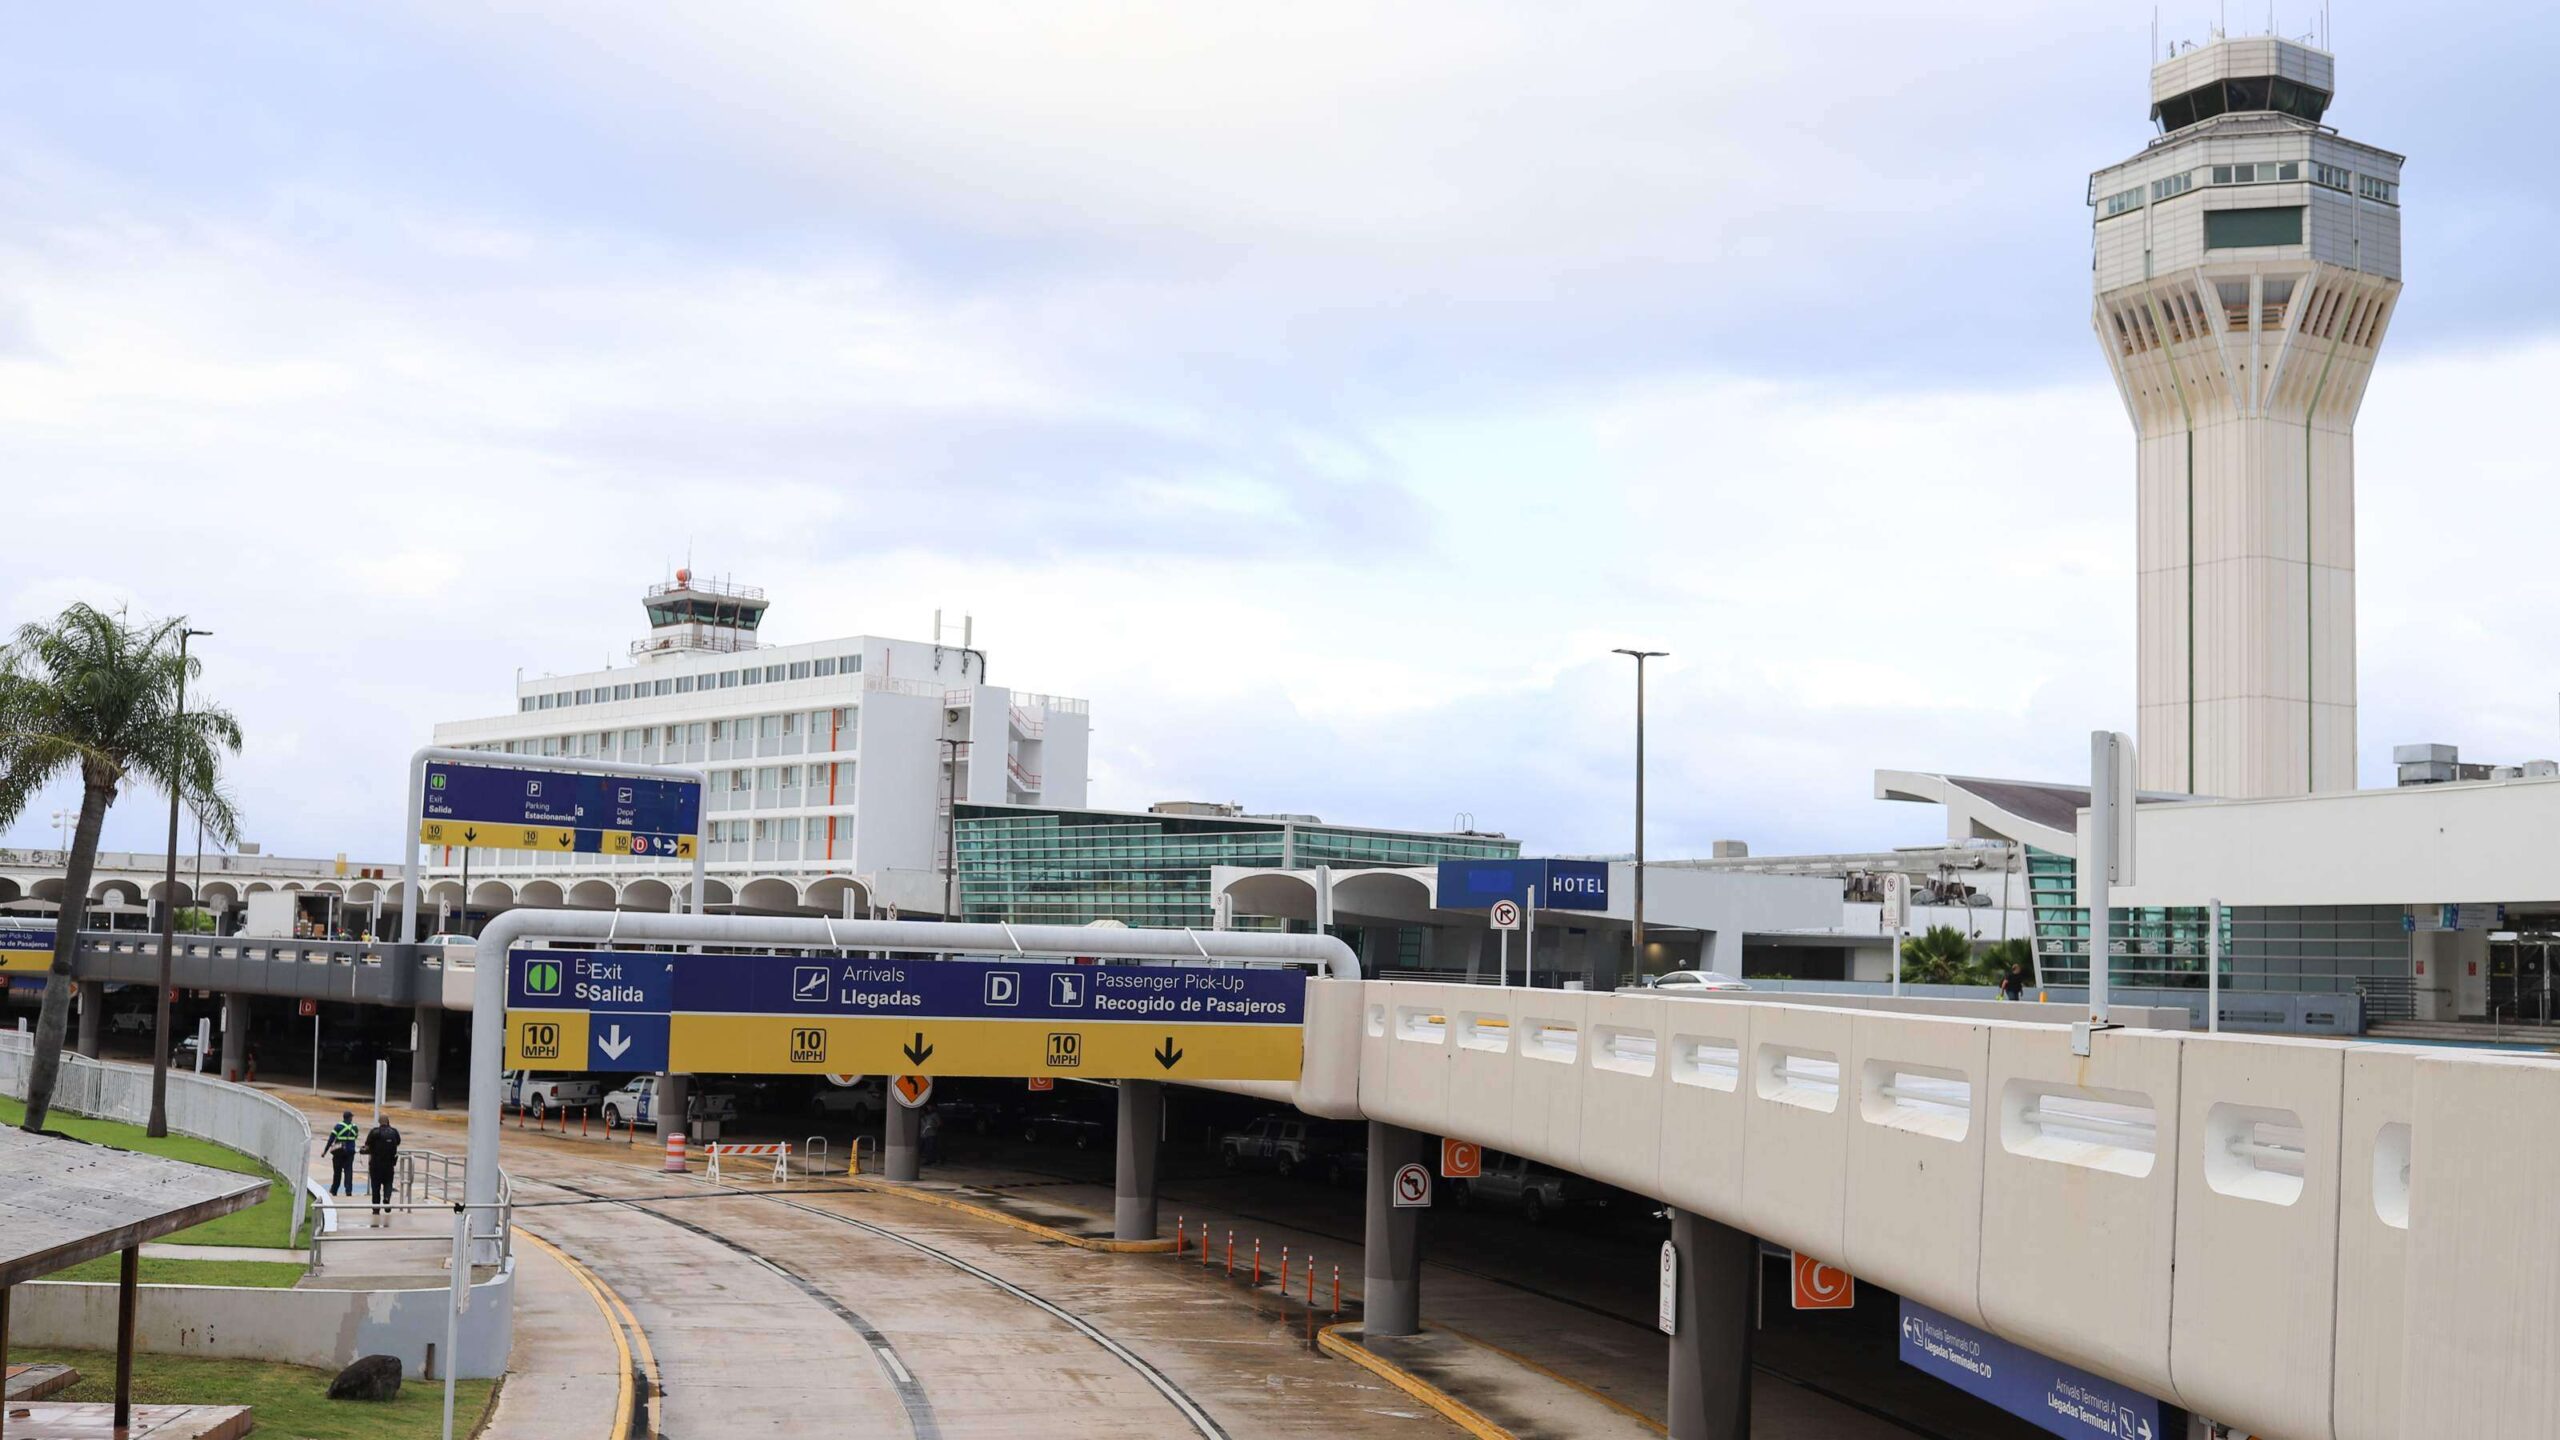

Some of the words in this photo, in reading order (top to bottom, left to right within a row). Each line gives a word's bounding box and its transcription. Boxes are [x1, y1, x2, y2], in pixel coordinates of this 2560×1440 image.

[530, 784, 538, 794] P
[429, 795, 443, 803] Exit
[525, 801, 550, 811] Parking
[429, 805, 452, 814] Salida
[617, 808, 636, 817] Depa
[430, 825, 440, 835] 10
[526, 832, 536, 841] 10
[618, 837, 626, 845] 10
[637, 839, 644, 850] D
[1552, 876, 1605, 894] HOTEL
[843, 966, 905, 983] Arrivals
[1095, 972, 1180, 992] Passenger
[1185, 974, 1245, 992] Pick-Up
[589, 985, 644, 1002] Salida
[991, 977, 1013, 1001] D
[305, 1002, 312, 1012] D
[841, 989, 921, 1008] Llegadas
[1095, 995, 1176, 1014] Recogido
[1181, 996, 1201, 1012] de
[1206, 997, 1286, 1016] Pasajeros
[528, 1025, 554, 1045] 10
[796, 1030, 821, 1050] 10
[525, 1046, 555, 1057] MPH
[1052, 1035, 1076, 1055] 10
[793, 1050, 823, 1061] MPH
[1049, 1055, 1078, 1065] MPH
[1454, 1146, 1468, 1168] C
[1812, 1264, 1835, 1295] C
[1925, 1322, 1943, 1341] Arrivals
[1943, 1329, 1969, 1351] Terminals
[1969, 1340, 1980, 1356] C/D
[1924, 1339, 1948, 1360] Llegadas
[1948, 1348, 1978, 1373] Terminales
[1979, 1362, 1992, 1378] C/D
[2056, 1378, 2080, 1401] Arrivals
[2080, 1387, 2110, 1414] Terminal
[2110, 1401, 2117, 1415] A
[2048, 1391, 2079, 1418] Llegadas
[2079, 1404, 2110, 1433] Terminal
[2110, 1422, 2118, 1436] A
